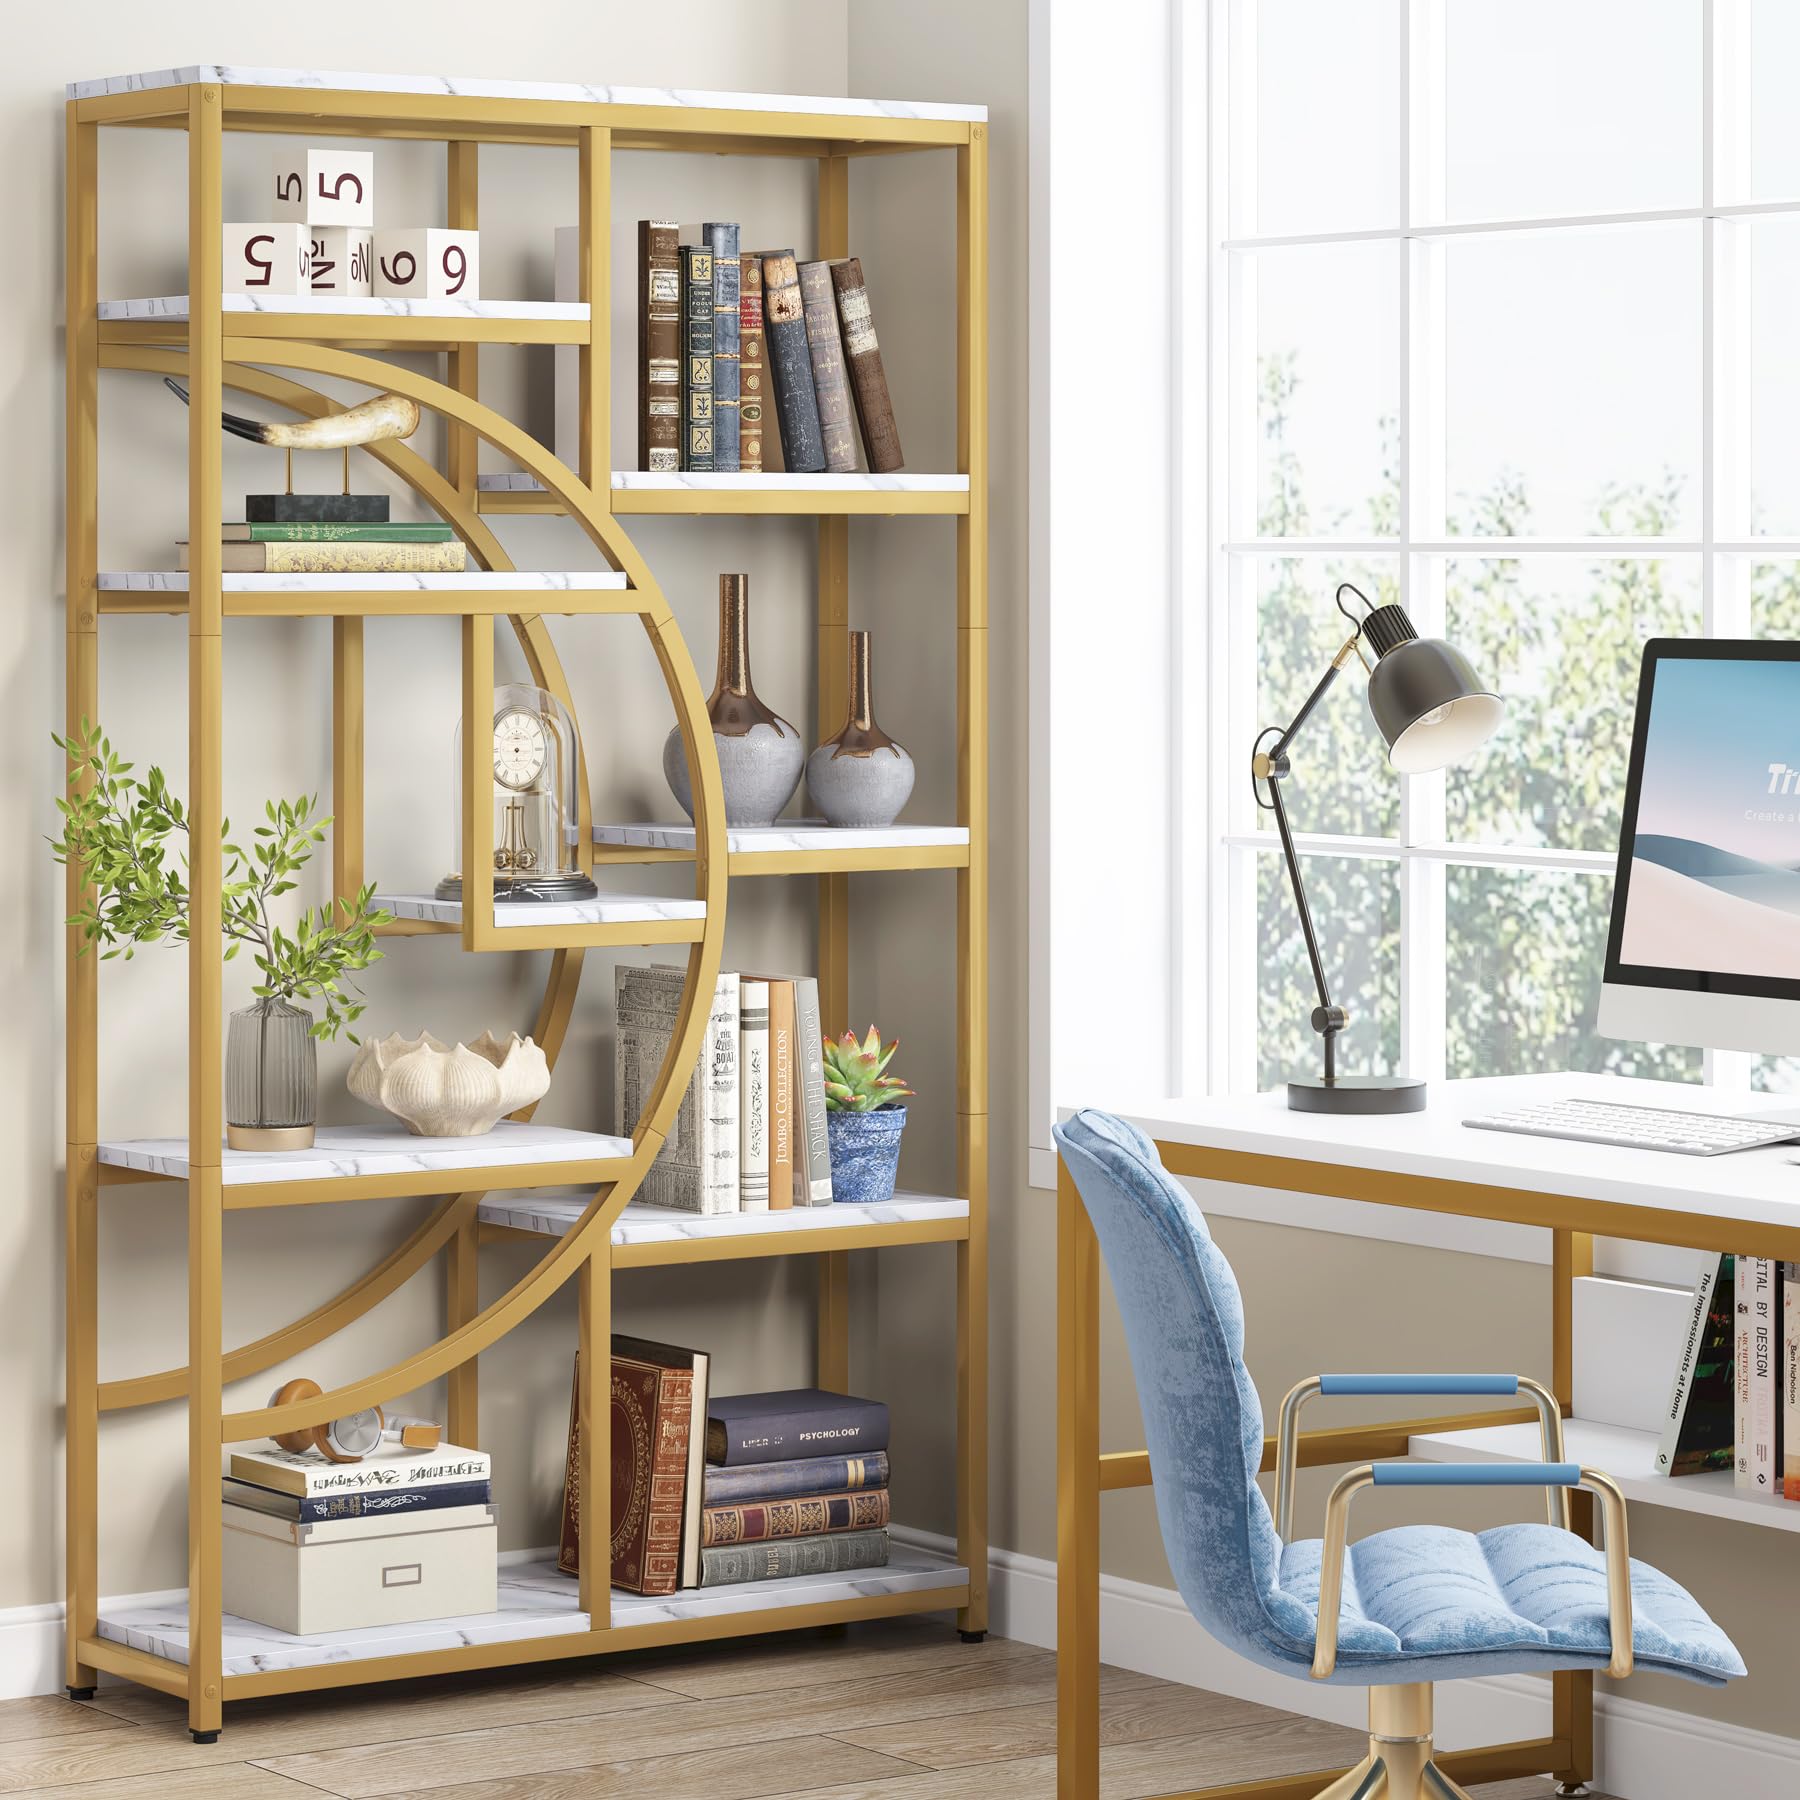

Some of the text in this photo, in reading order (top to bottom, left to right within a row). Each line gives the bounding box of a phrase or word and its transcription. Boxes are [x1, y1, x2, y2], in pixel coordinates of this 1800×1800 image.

[319, 172, 363, 204] 5
[244, 235, 275, 285] 5
[1744, 809, 1785, 822] Create
[716, 1052, 734, 1064] BOAT
[776, 1029, 789, 1166] JUMBO COLLECTION
[804, 1006, 826, 1161] YOUNG THE SHACK
[1756, 1302, 1768, 1318] BY
[1671, 1272, 1711, 1420] The Impressionists at Home
[1756, 1327, 1767, 1378] DESIGN
[1789, 1361, 1797, 1404] Nicholson
[799, 1427, 860, 1441] PSYCHOLOGY
